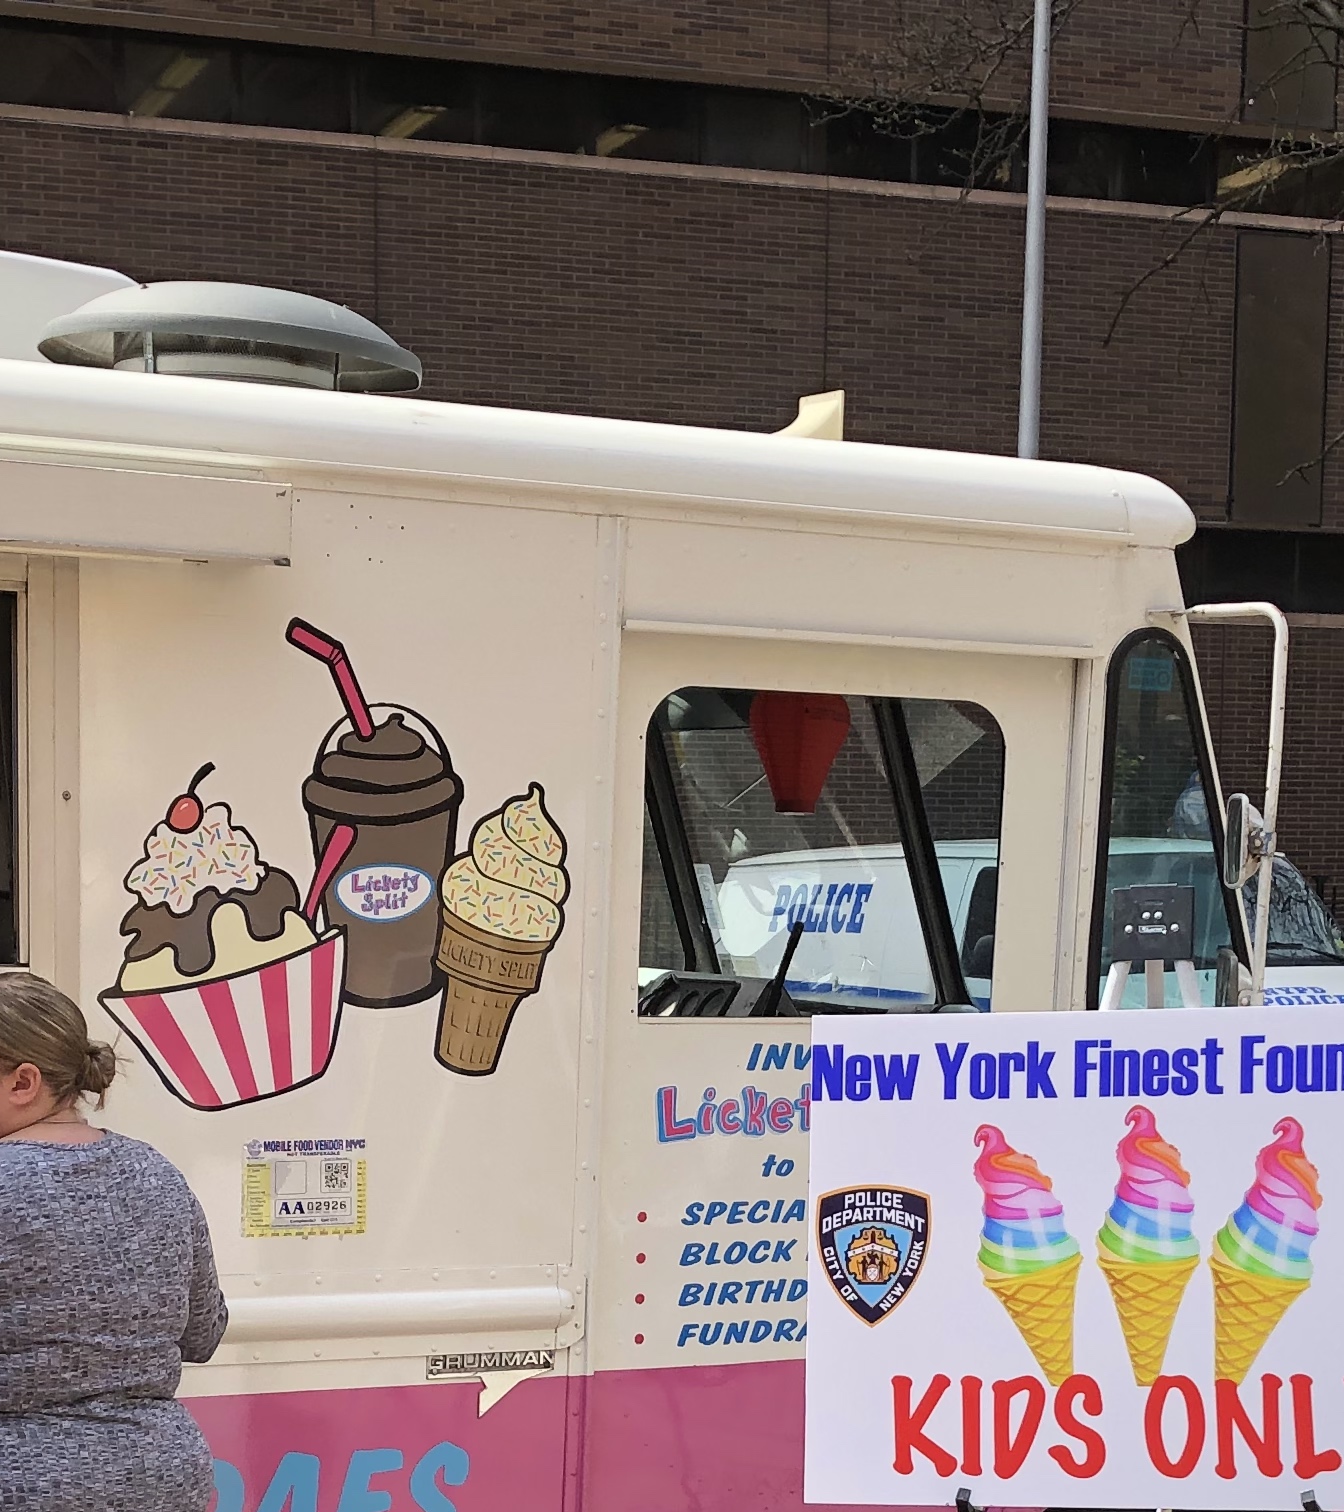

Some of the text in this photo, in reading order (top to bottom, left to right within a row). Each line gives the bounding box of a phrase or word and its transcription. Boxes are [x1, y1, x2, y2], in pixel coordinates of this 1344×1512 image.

[351, 871, 421, 893] Lickety
[360, 892, 409, 916] Split
[768, 883, 874, 934] POLICE
[440, 936, 538, 981] LICKETY SPLIT
[811, 1044, 919, 1103] New
[937, 1040, 1059, 1101] York
[1073, 1037, 1225, 1099] Finest
[264, 1140, 292, 1152] MOBILE
[294, 1140, 314, 1152] FOOD
[315, 1139, 344, 1151] VENDOR
[761, 1154, 795, 1177] to
[844, 1191, 904, 1209] POLICE
[822, 1207, 925, 1235] DEPARTMENT
[679, 1238, 798, 1266] BLOCK
[823, 1246, 858, 1302] CITY OF
[879, 1240, 925, 1312] NEW YORK
[678, 1278, 808, 1307] BIRTHD
[428, 1350, 554, 1370] GRUMMAN
[891, 1373, 1107, 1480] KIDS
